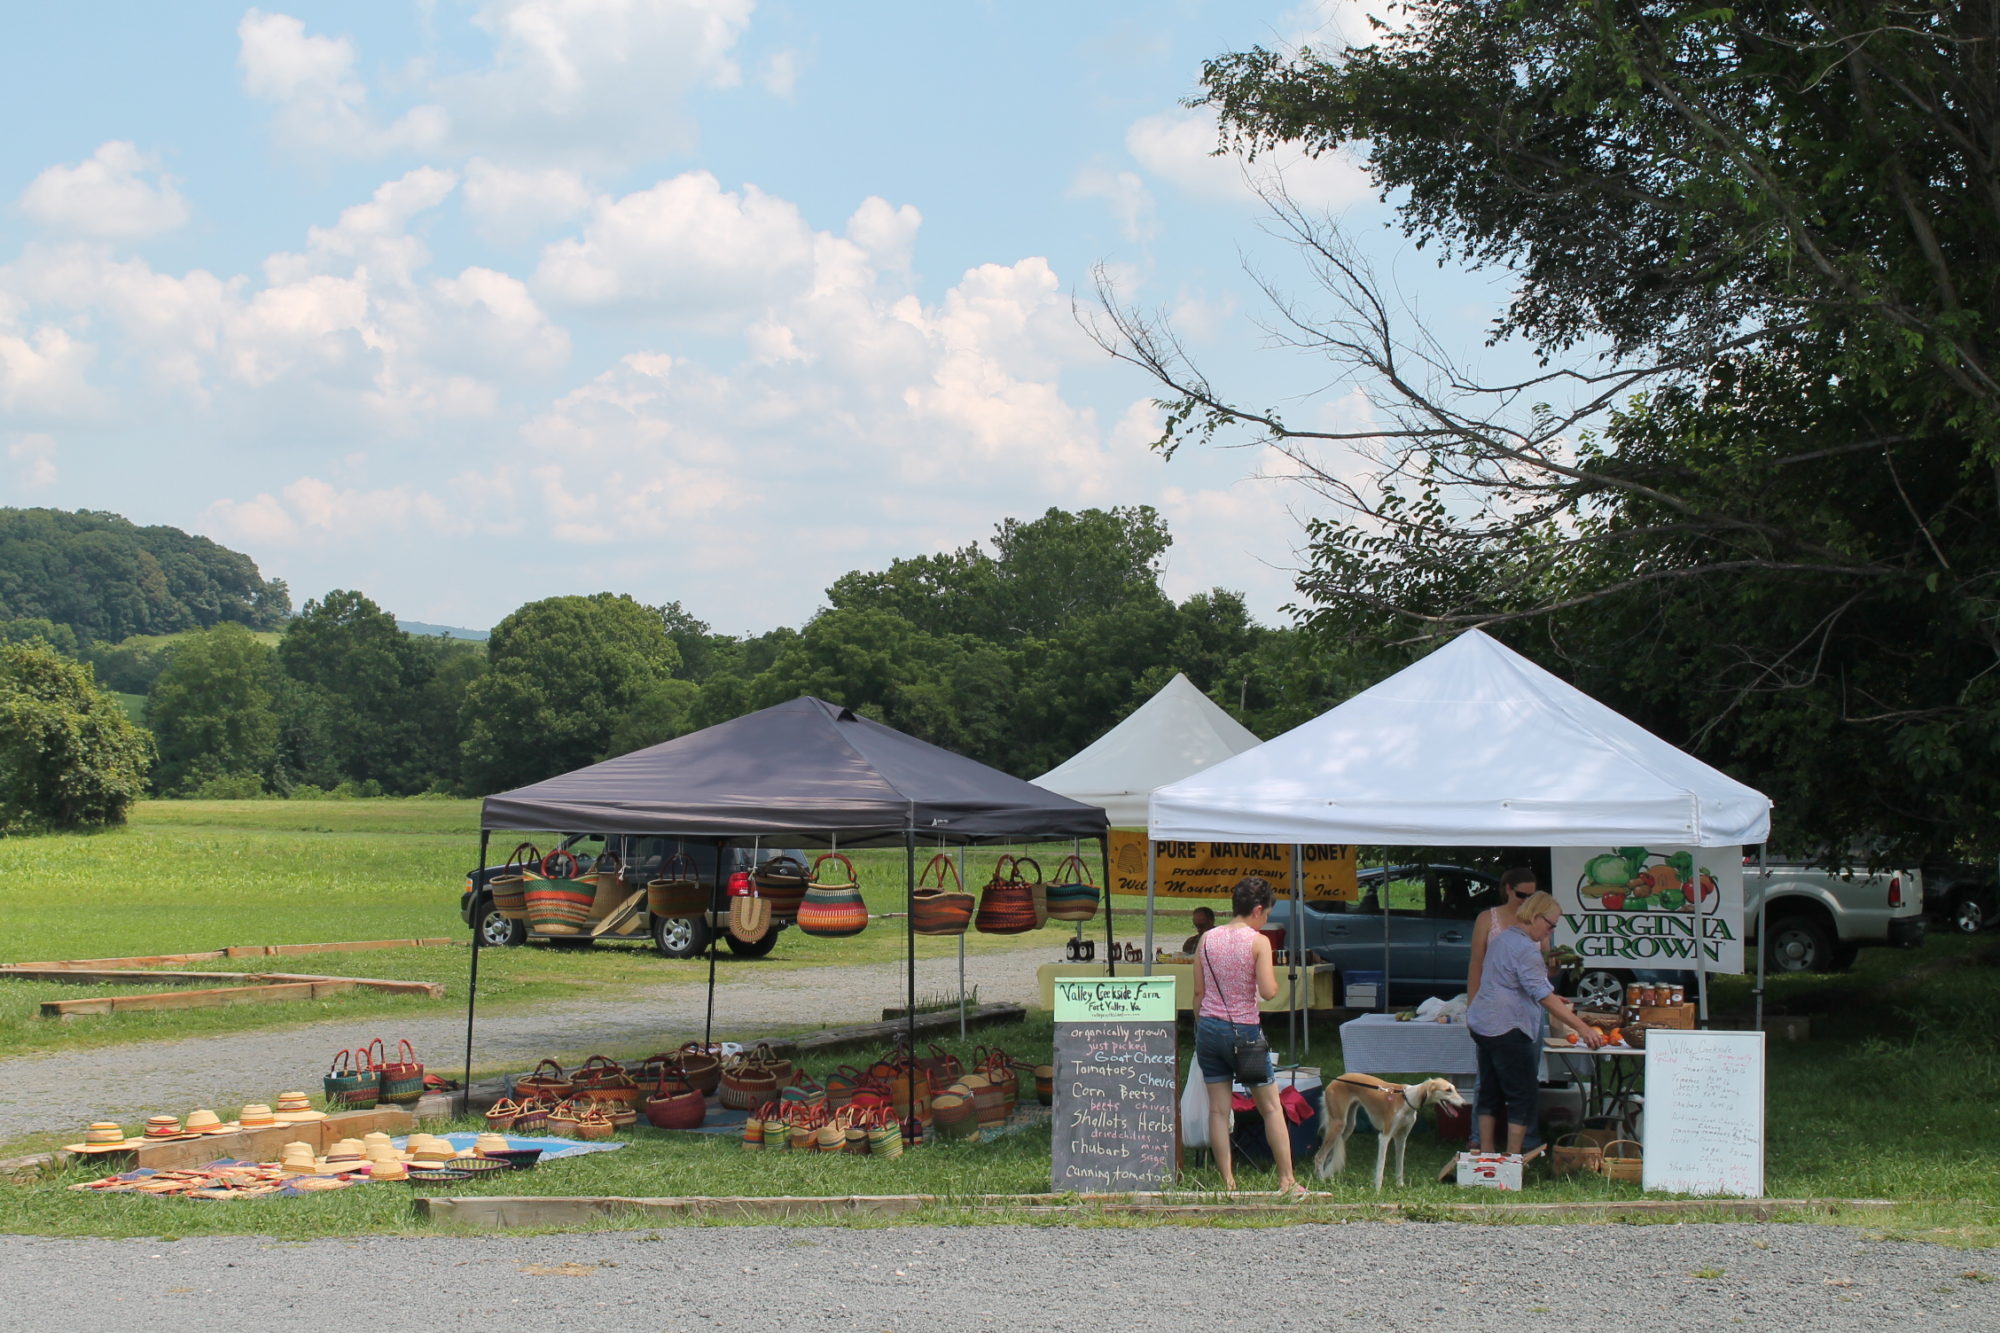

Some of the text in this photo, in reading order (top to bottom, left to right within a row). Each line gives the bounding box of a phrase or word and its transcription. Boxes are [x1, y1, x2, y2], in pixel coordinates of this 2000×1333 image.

[1156, 841, 1196, 858] PURE
[1210, 842, 1281, 861] NATURAL
[1171, 868, 1238, 876] Produced
[1242, 868, 1287, 879] Locally
[1118, 877, 1156, 890] Wil
[1164, 880, 1237, 893] Mounta
[1563, 914, 1736, 940] VIRGINIA
[1575, 936, 1723, 962] GROWN
[1060, 982, 1092, 1004] Valley
[1133, 982, 1161, 1000] Farm
[1071, 1023, 1168, 1042] organically grown
[1086, 1039, 1147, 1056] just picked
[1094, 1051, 1175, 1064] Goat Cheese
[1071, 1060, 1136, 1079] Tomatoes
[1138, 1073, 1175, 1089] Chevre
[1072, 1082, 1156, 1101] Corn Beets
[1090, 1099, 1120, 1112] beets
[1070, 1109, 1174, 1133] Shallots Herbs
[1071, 1138, 1130, 1157] rhubarb
[1140, 1138, 1169, 1152] mint
[1065, 1164, 1173, 1186] canning tomatoes
